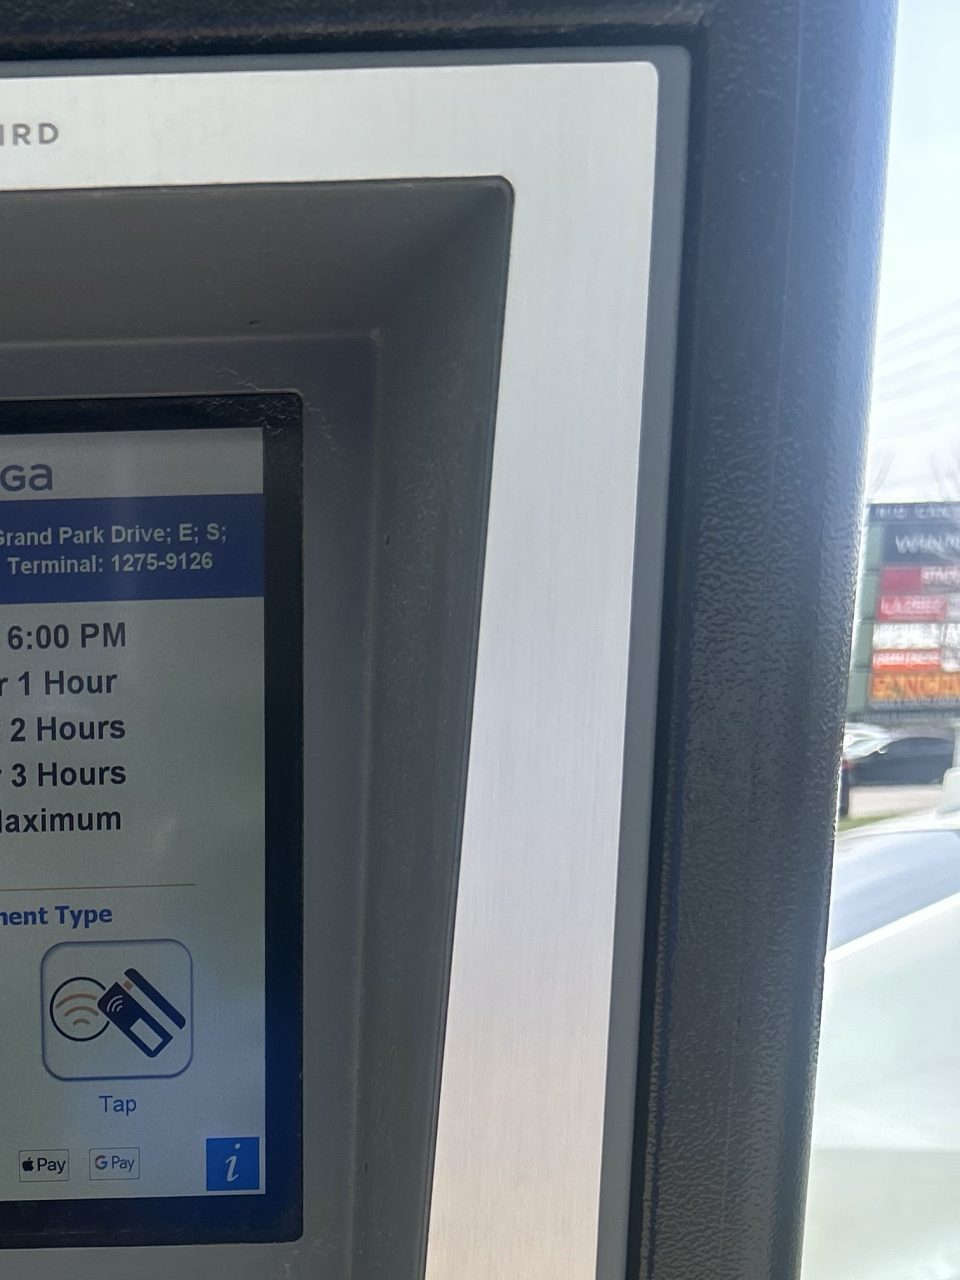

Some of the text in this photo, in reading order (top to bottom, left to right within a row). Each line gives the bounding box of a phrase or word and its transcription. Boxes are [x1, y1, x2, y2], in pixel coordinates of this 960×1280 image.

[58, 525, 104, 545] Park
[111, 523, 173, 545] Drive;
[178, 523, 199, 543] E;
[205, 523, 227, 543] S;
[7, 552, 214, 576] Terminal: 1275-9126
[6, 625, 70, 652] 6:00
[80, 622, 127, 649] PM
[18, 672, 31, 696] 1
[43, 670, 118, 696] Hour
[9, 718, 26, 743] 2
[36, 715, 127, 743] Hours
[10, 763, 27, 789] 3
[37, 761, 127, 788] Hours
[54, 905, 114, 927] Type
[98, 1096, 138, 1117] Tap
[38, 1157, 66, 1175] Pay
[112, 1156, 135, 1173] Pay
